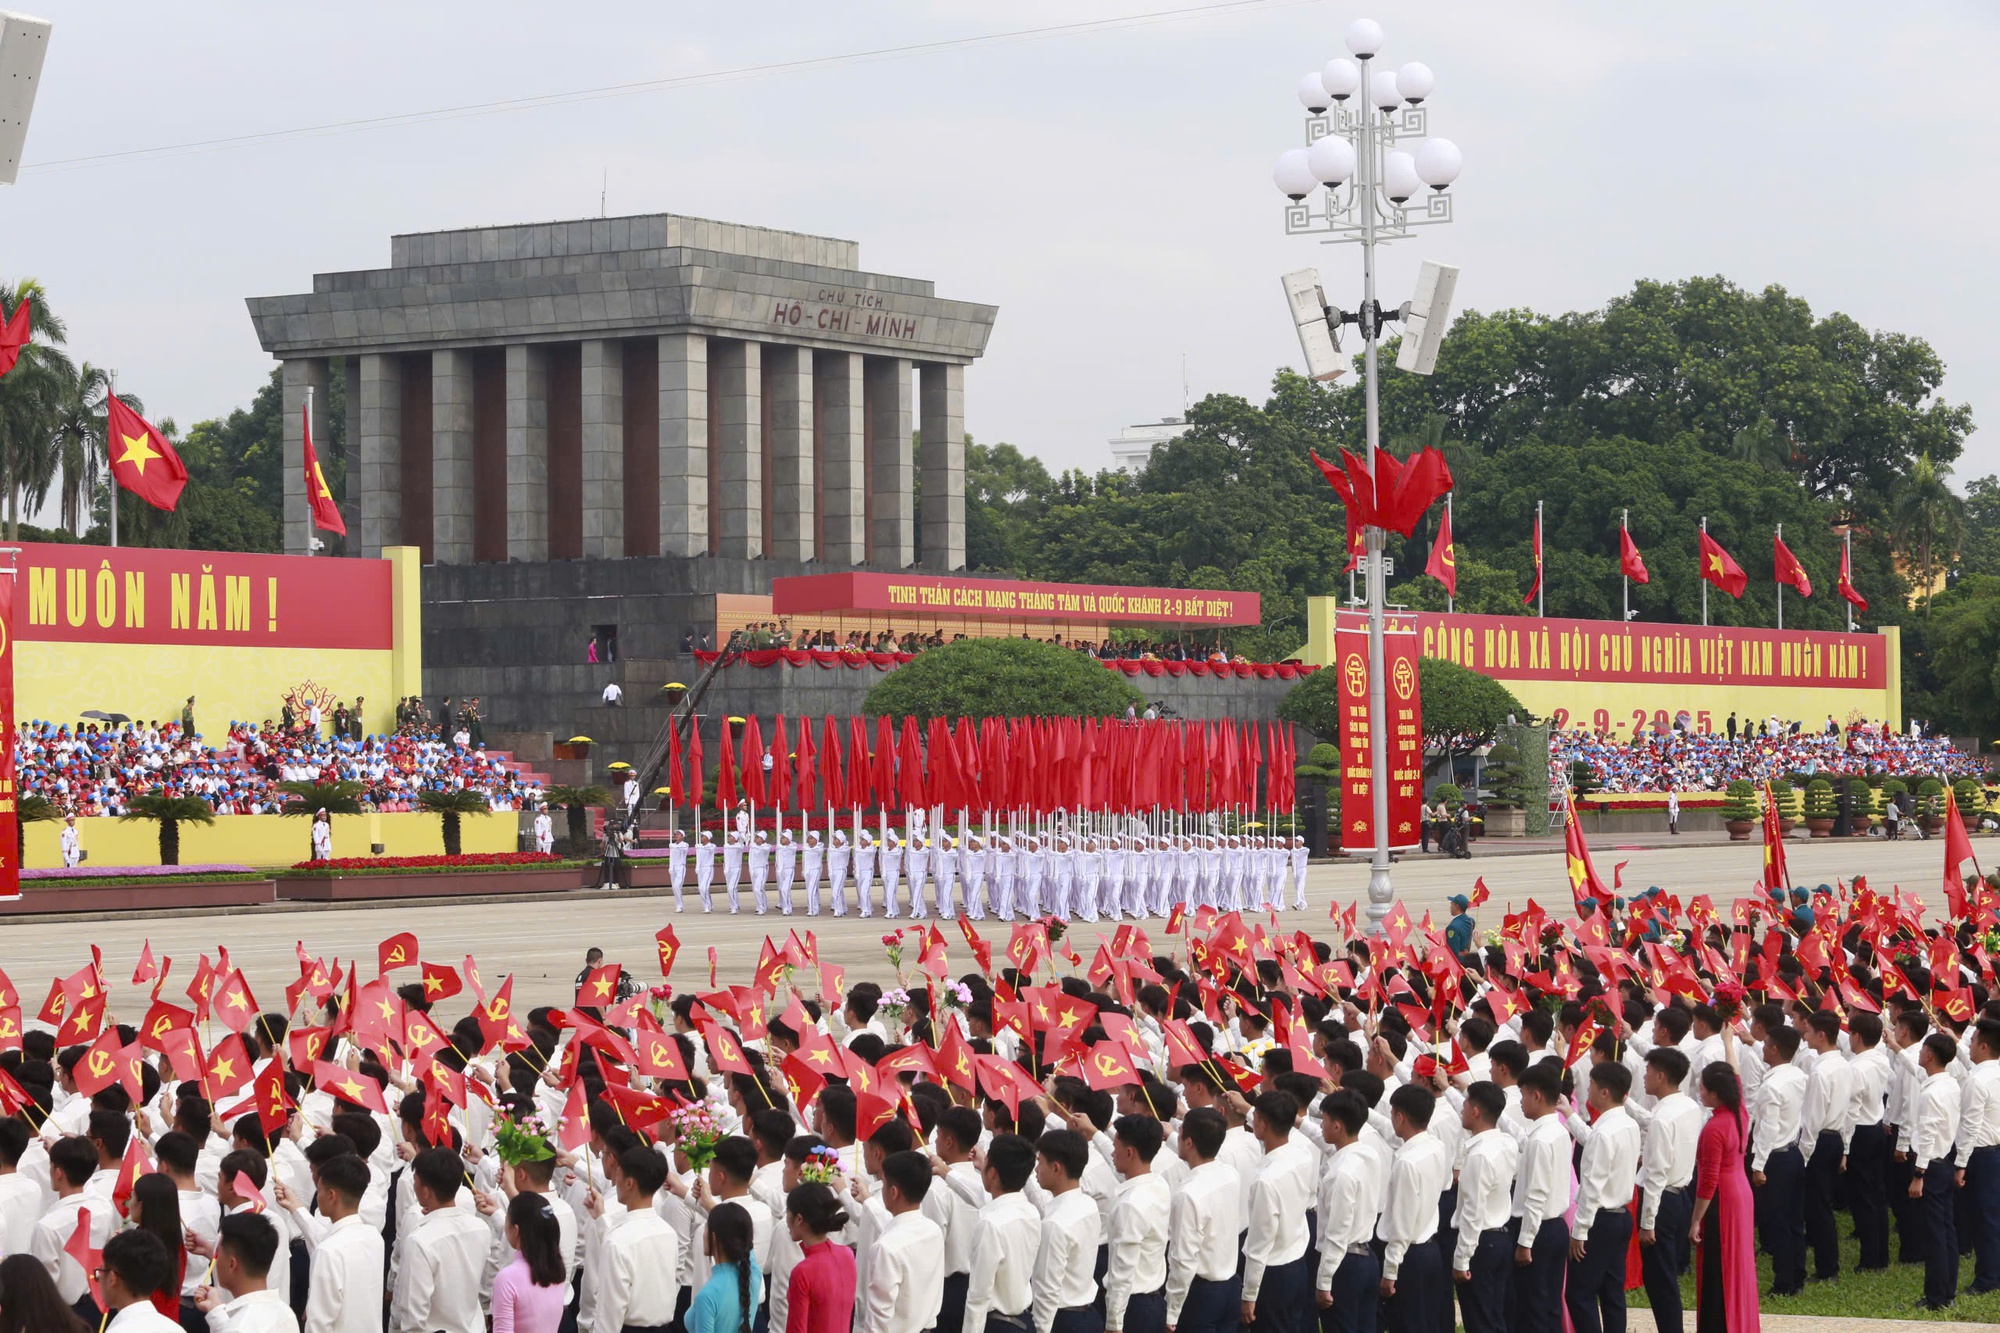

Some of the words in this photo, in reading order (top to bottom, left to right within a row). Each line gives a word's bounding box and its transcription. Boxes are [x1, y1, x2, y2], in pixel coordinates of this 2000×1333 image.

[29, 559, 145, 628] MUÔN
[171, 564, 250, 631] NĂM
[888, 585, 917, 604] TINH
[920, 582, 951, 605] THẦN
[954, 585, 983, 607] CÁCH
[985, 590, 1017, 611] MẠNG
[1019, 589, 1055, 610] THÁNG
[1057, 591, 1080, 611] TÁM
[1083, 592, 1096, 612] VÀ
[1099, 592, 1125, 614] QUỐC
[1128, 594, 1162, 615] KHÁNH
[1164, 599, 1182, 616] 2-9
[1185, 595, 1204, 616] BẤT
[1485, 623, 1519, 669] HÒA
[1529, 626, 1551, 669] XÃ
[1560, 626, 1590, 678] HỘI
[1600, 626, 1632, 672] CHỦ
[1642, 632, 1691, 674] NGHĨA
[1700, 633, 1733, 682] VIỆT
[1741, 640, 1773, 676] NAM
[1781, 637, 1821, 678] MUÔN
[1553, 708, 1712, 736] 2-9-205
